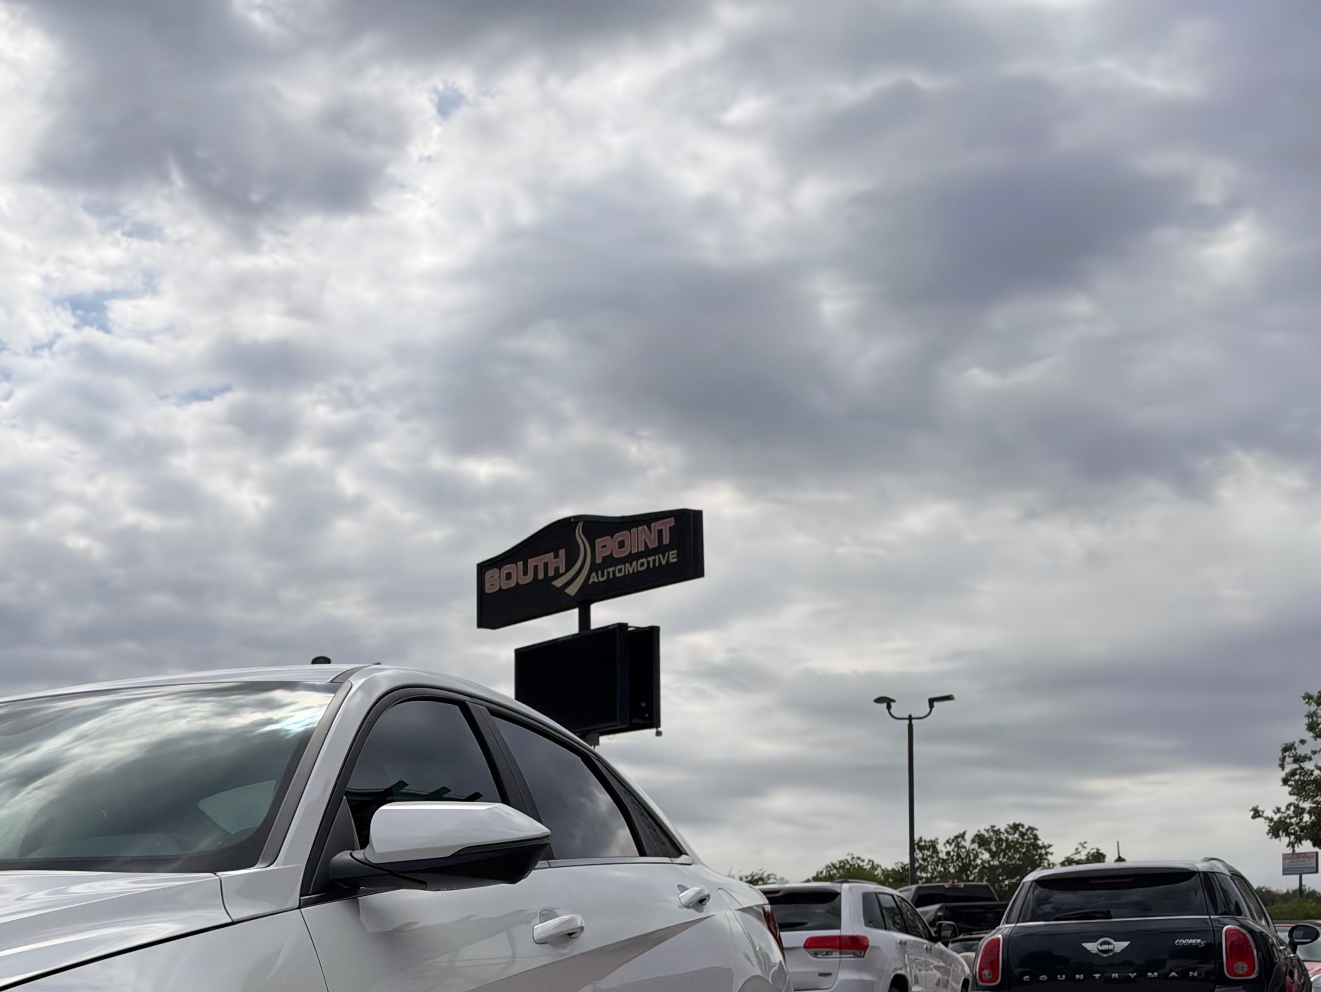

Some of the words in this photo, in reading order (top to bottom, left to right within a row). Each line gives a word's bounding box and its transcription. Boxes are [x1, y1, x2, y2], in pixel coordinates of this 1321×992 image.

[485, 549, 566, 593] SOUTH
[595, 517, 675, 564] POINT
[588, 550, 678, 584] AUTOMOTIVE
[1023, 971, 1198, 981] COUNTRYMAN
